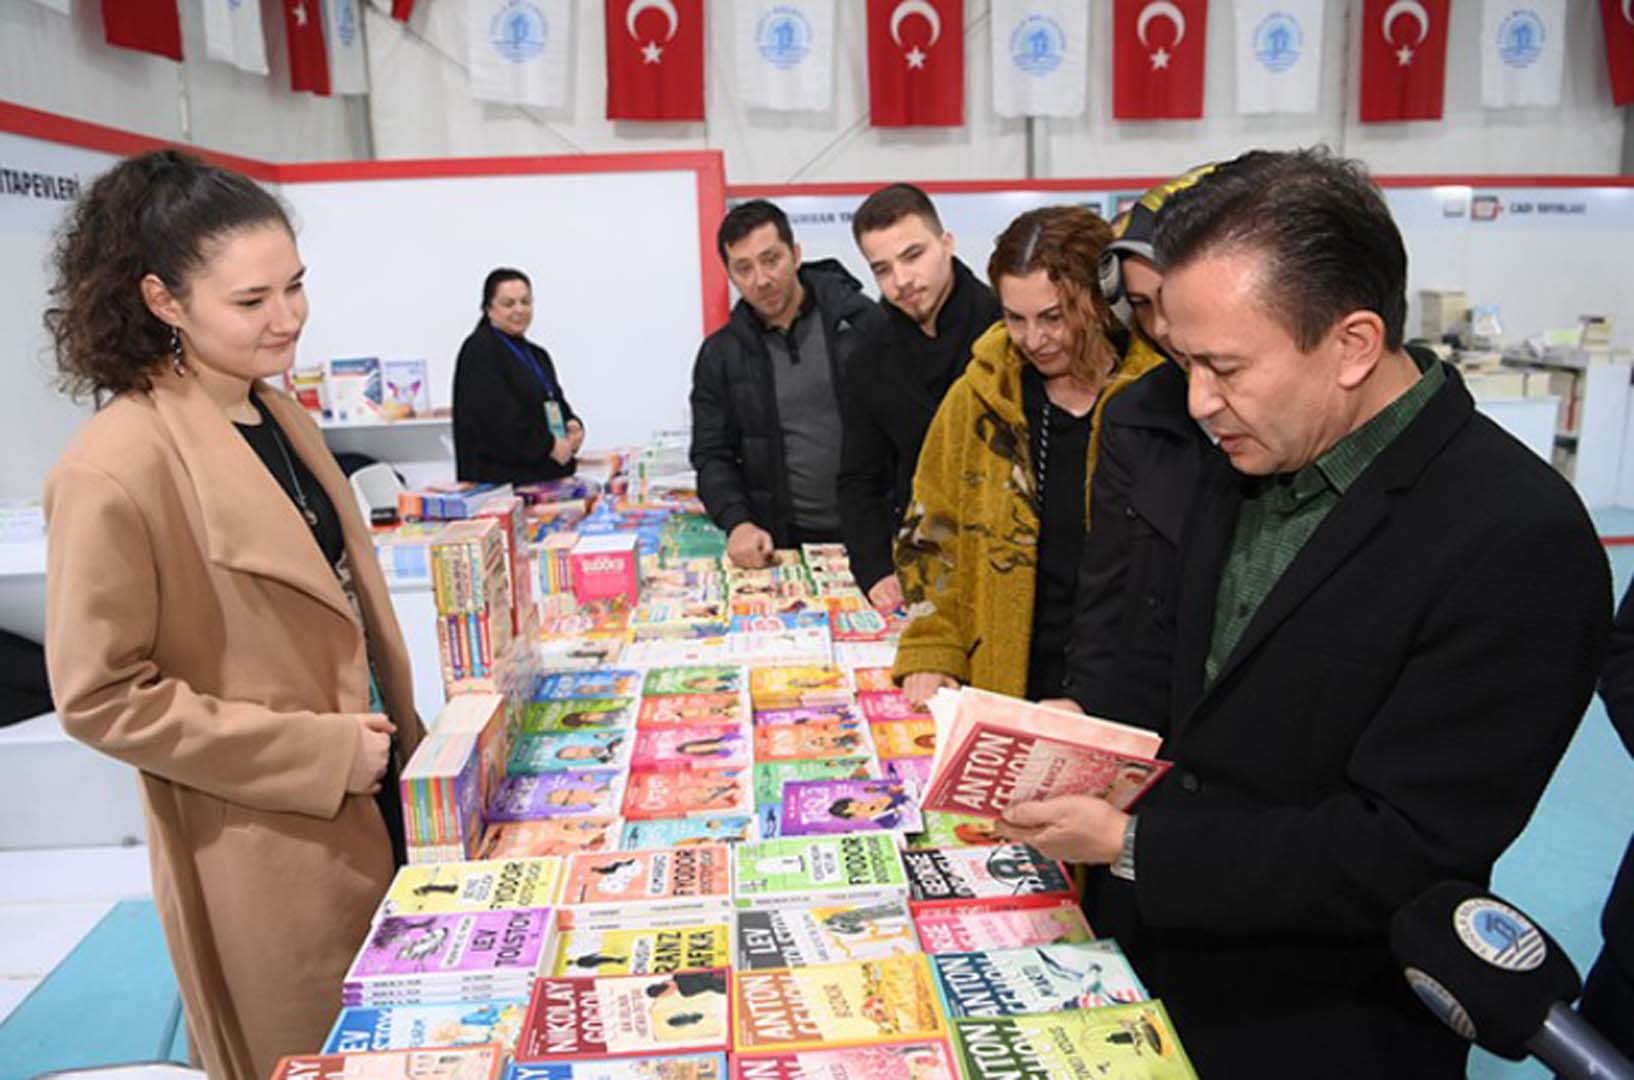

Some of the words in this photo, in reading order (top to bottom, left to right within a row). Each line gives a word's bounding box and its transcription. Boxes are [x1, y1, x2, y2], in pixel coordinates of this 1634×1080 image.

[952, 731, 1015, 810] ANTON
[672, 850, 696, 896] FYODOR
[841, 836, 870, 885] FYODOR
[471, 928, 498, 952] LEV
[495, 910, 532, 968] TOLSTOY
[654, 931, 682, 974] RANZ
[687, 929, 714, 968] AFKA
[743, 926, 778, 954] LEV
[739, 974, 796, 1040] ANTON
[937, 954, 1000, 1018] ANTON
[540, 980, 578, 1053] NİKOLAY
[961, 1022, 1030, 1080] NTON
